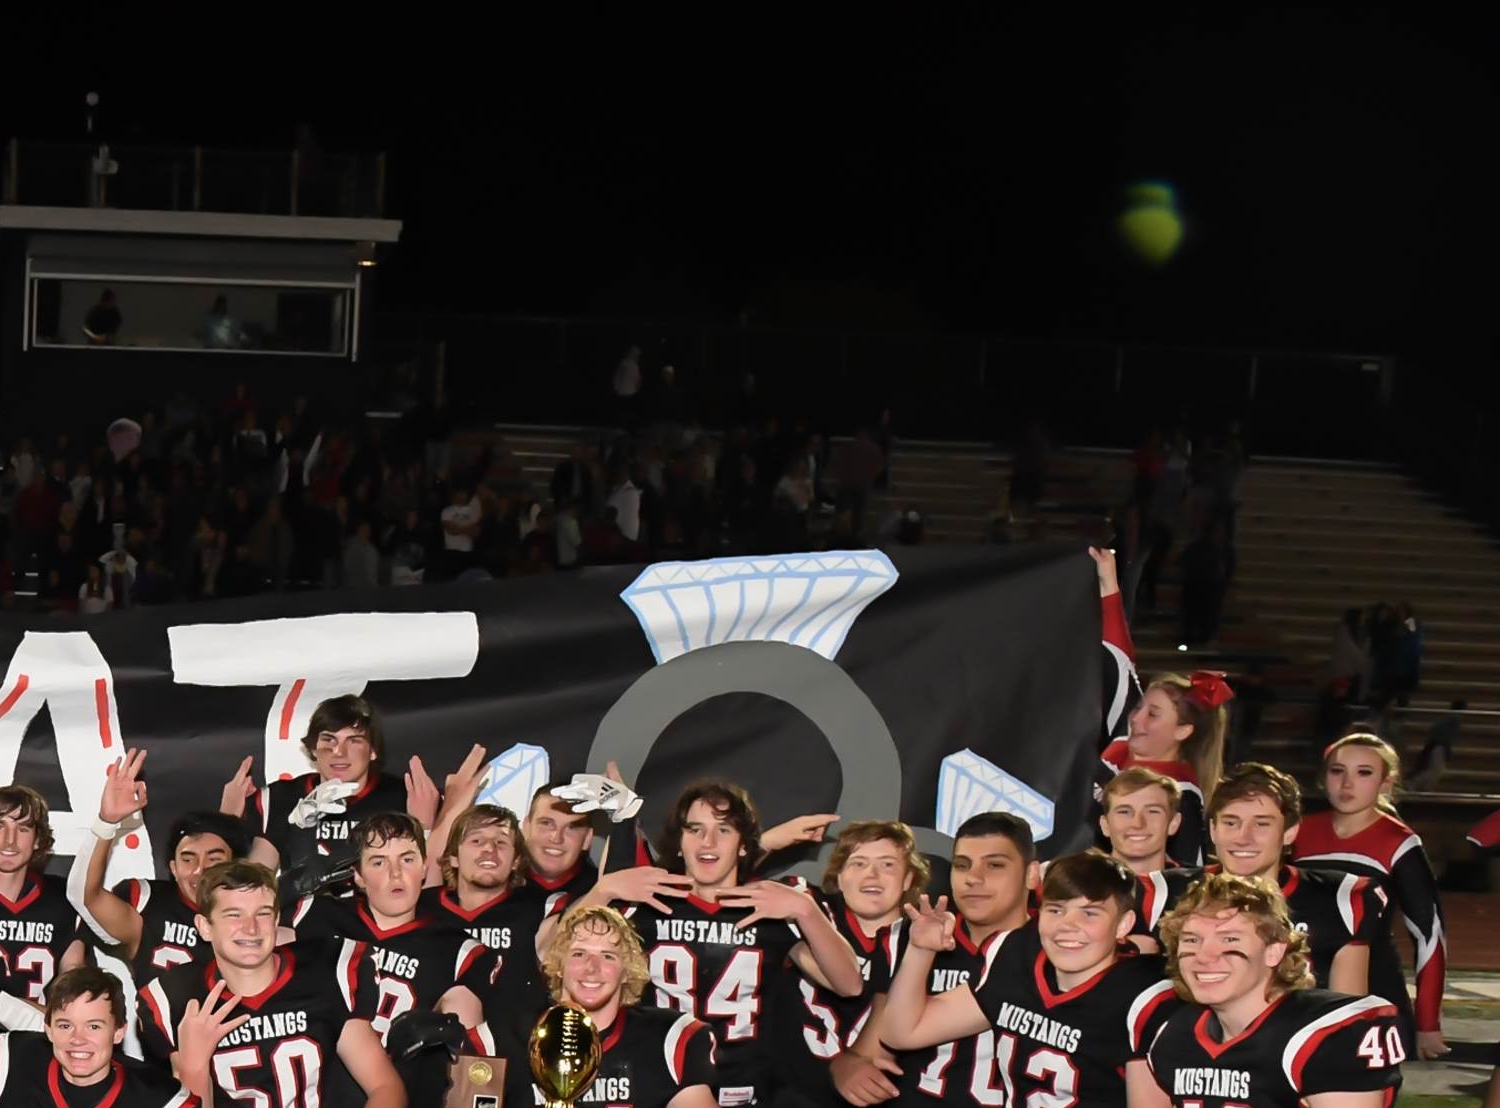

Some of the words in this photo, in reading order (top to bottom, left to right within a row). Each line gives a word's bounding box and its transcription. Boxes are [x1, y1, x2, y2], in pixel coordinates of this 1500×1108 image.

[655, 919, 758, 947] MUSTANGS
[649, 942, 764, 1042] 84
[996, 1001, 1083, 1054] MUSTANGS
[1356, 1024, 1407, 1070] 40
[1173, 1066, 1252, 1100] MUSTANGS
